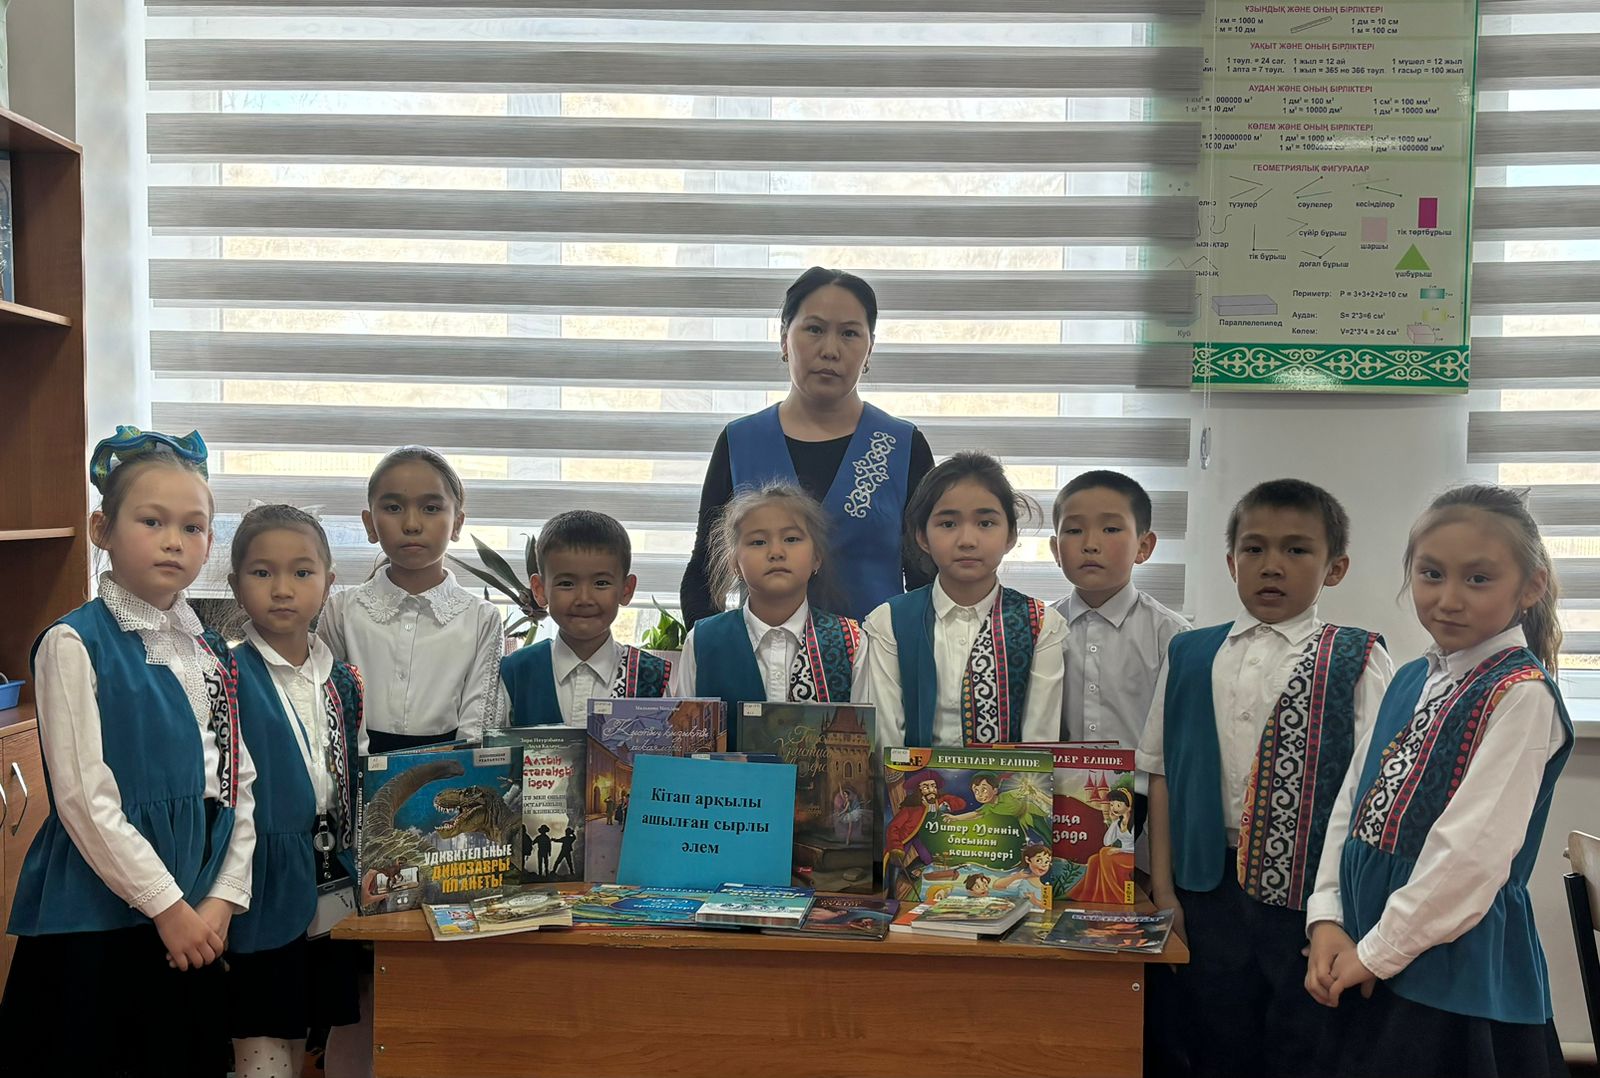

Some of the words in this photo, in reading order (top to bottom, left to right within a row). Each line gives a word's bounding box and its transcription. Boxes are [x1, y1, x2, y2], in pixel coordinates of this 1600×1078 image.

[1313, 6, 1339, 14] ОНЫҢ
[1250, 42, 1277, 50] УАҚЫТ
[1279, 42, 1303, 50] ЖӘНЕ
[1248, 85, 1275, 93] АУДАН
[1306, 106, 1328, 114] 10000
[1308, 134, 1325, 142] 1000
[1253, 164, 1320, 172] ГЕОМЕТРИЯЛЫҚ
[1320, 230, 1347, 238] бұрыш
[1260, 253, 1287, 261] бұрыш
[1376, 328, 1385, 336] 24
[938, 755, 996, 766] ЕРТЕГІЛЕР
[1000, 758, 1040, 768] ЕЛІНДЕ
[1083, 756, 1123, 766] ЕЛІНДЕ
[523, 766, 575, 778] стағанды
[651, 787, 690, 804] Кітап
[695, 795, 761, 809] арқылы
[641, 814, 709, 829] ашылған
[714, 822, 769, 835] сырлы
[1053, 814, 1080, 826] ақа
[925, 821, 968, 834] Питер
[972, 824, 1020, 837] Пеннің
[948, 835, 997, 847] басынан
[1053, 831, 1088, 844] зада
[682, 842, 719, 854] әлем
[423, 844, 512, 866] УДИВИТЕЛЬНЫЕ
[949, 848, 1013, 861] кешкендері
[432, 857, 510, 881] ДИНОЗАВРЫ
[442, 874, 503, 893] ПЛАНЕТЫ
